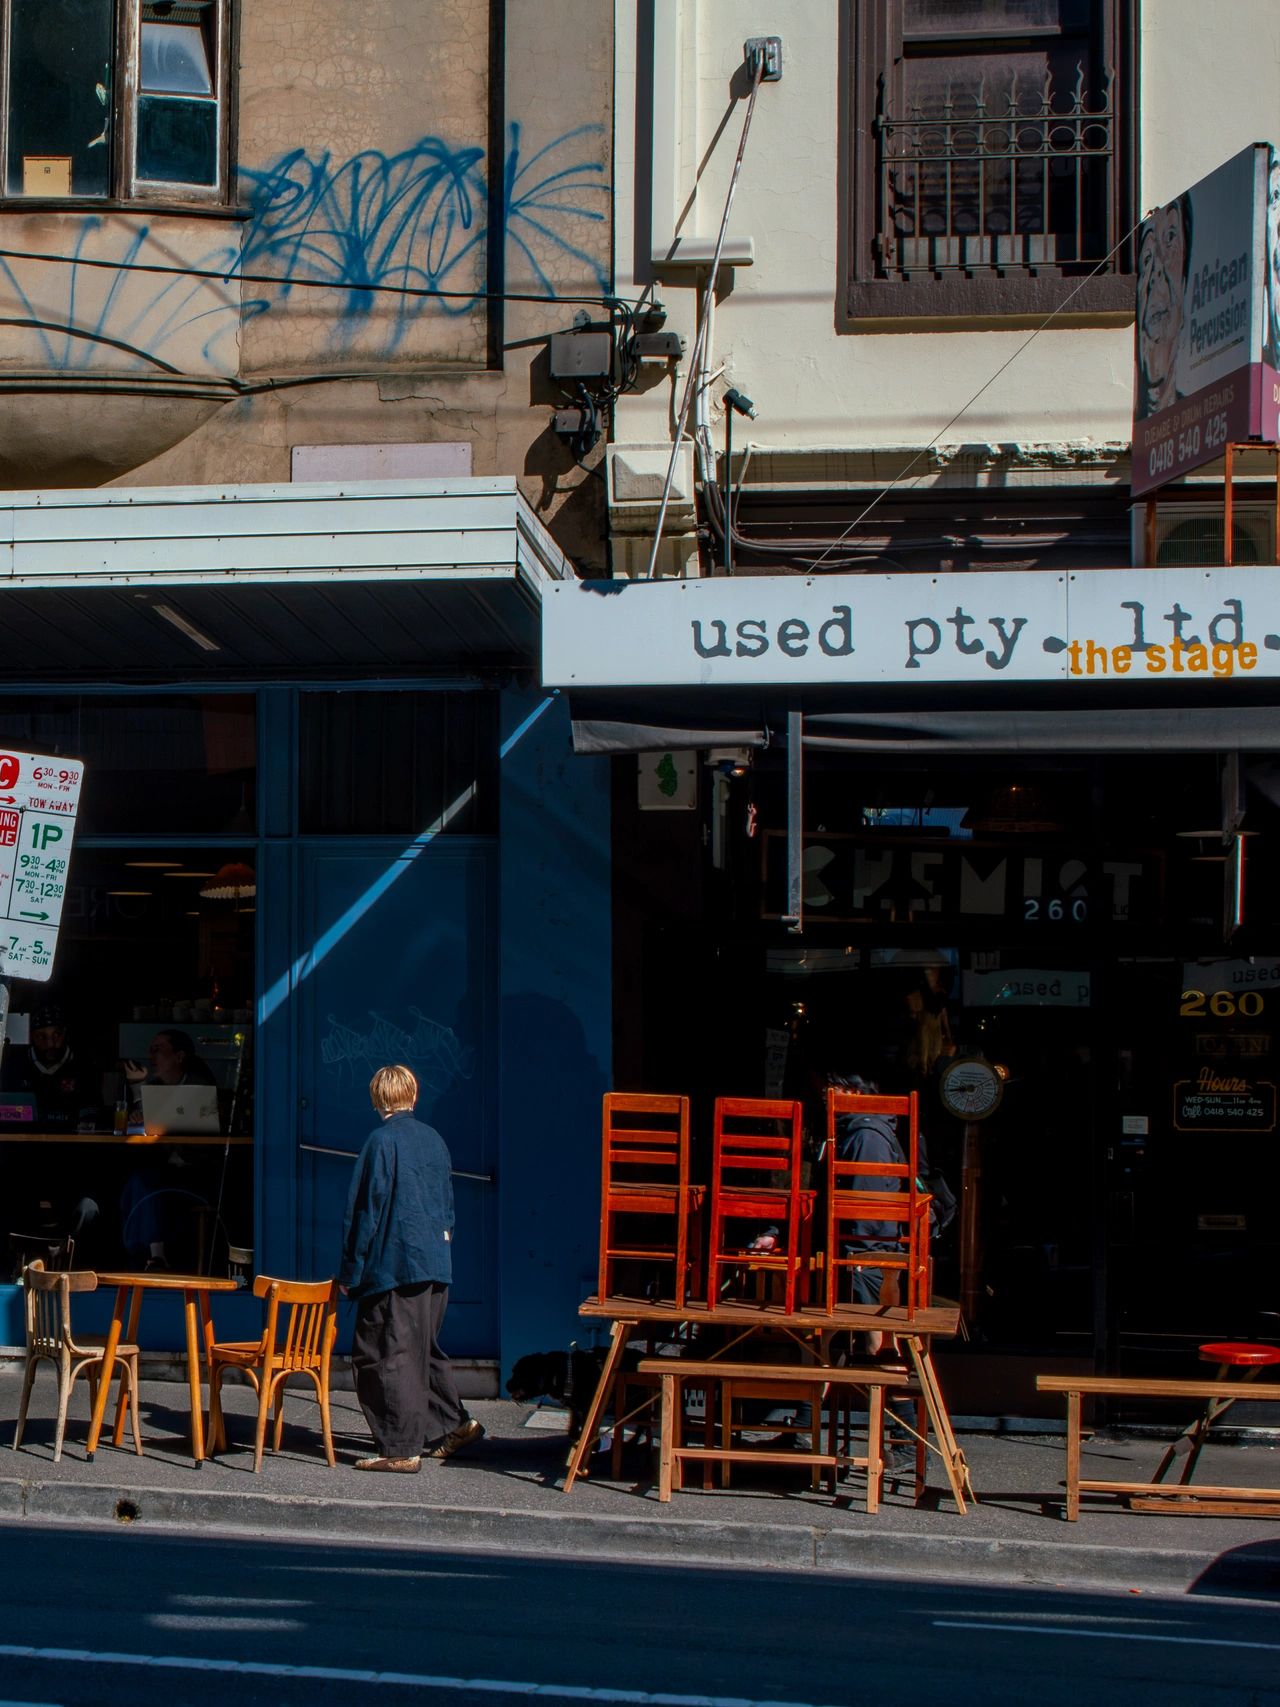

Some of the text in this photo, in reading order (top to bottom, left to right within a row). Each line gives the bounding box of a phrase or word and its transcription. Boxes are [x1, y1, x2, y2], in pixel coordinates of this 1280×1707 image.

[1191, 252, 1248, 314] African
[1190, 295, 1247, 356] Percussion
[1145, 418, 1172, 446] DJEMBE
[1182, 403, 1202, 429] DRUM
[1204, 384, 1235, 416] REPAIRS
[1149, 411, 1228, 477] 0418 540 425
[691, 606, 856, 659] used
[1067, 636, 1258, 679] the stage
[29, 797, 74, 812] TOW AWAY
[32, 823, 63, 850] 1P
[30, 896, 44, 904] SAT
[1023, 899, 1089, 921] 260
[1179, 989, 1264, 1016] 260
[1200, 1066, 1253, 1091] Hours
[1204, 1108, 1225, 1116] 0418
[1227, 1108, 1244, 1116] 540
[1246, 1108, 1265, 1117] 425
